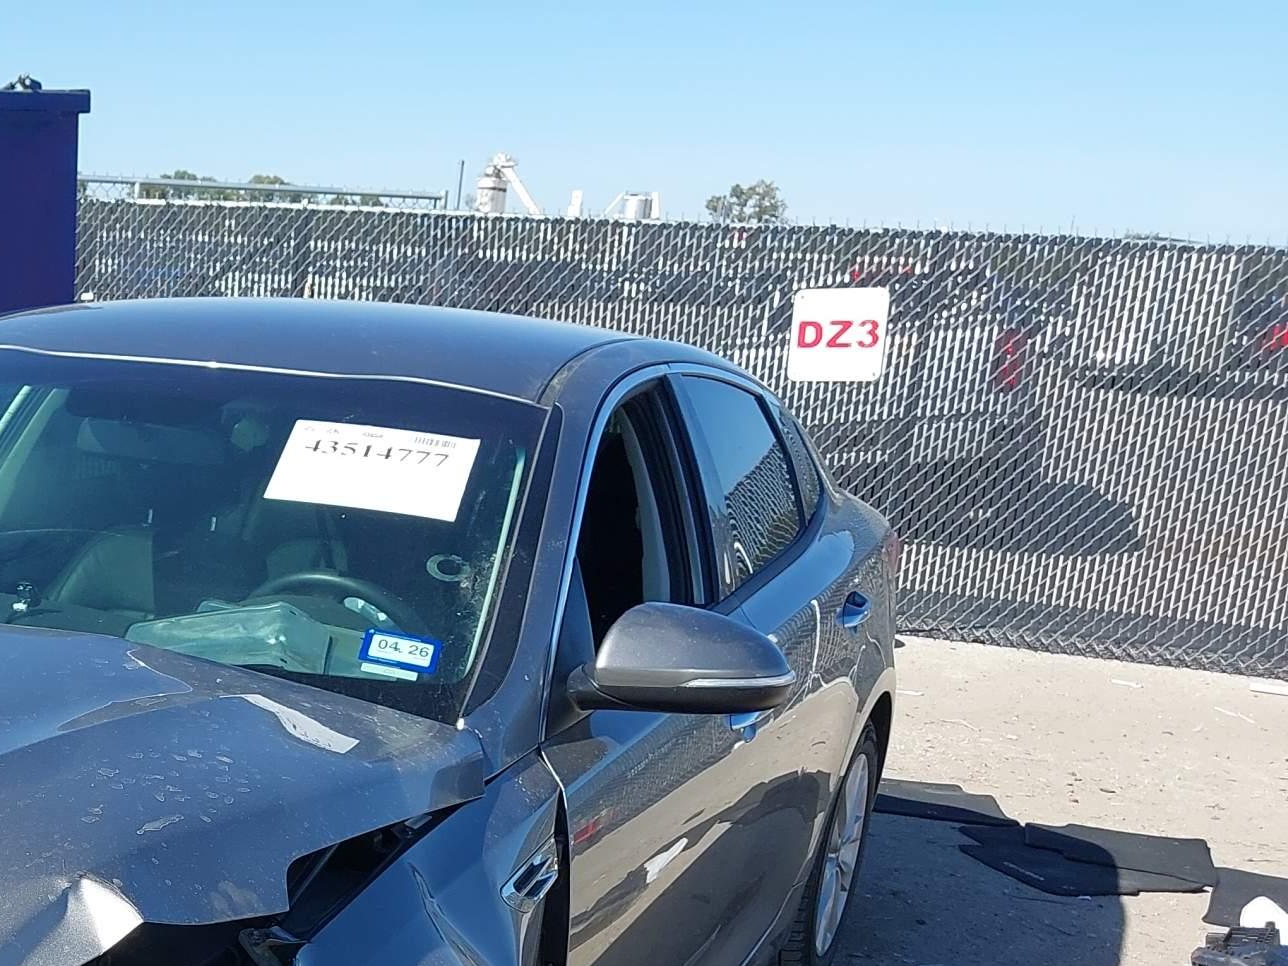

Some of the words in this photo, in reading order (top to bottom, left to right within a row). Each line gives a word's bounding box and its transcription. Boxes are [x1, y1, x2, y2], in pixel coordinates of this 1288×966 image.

[797, 319, 879, 348] DZ3
[304, 439, 449, 467] 43514777
[408, 644, 430, 658] 26
